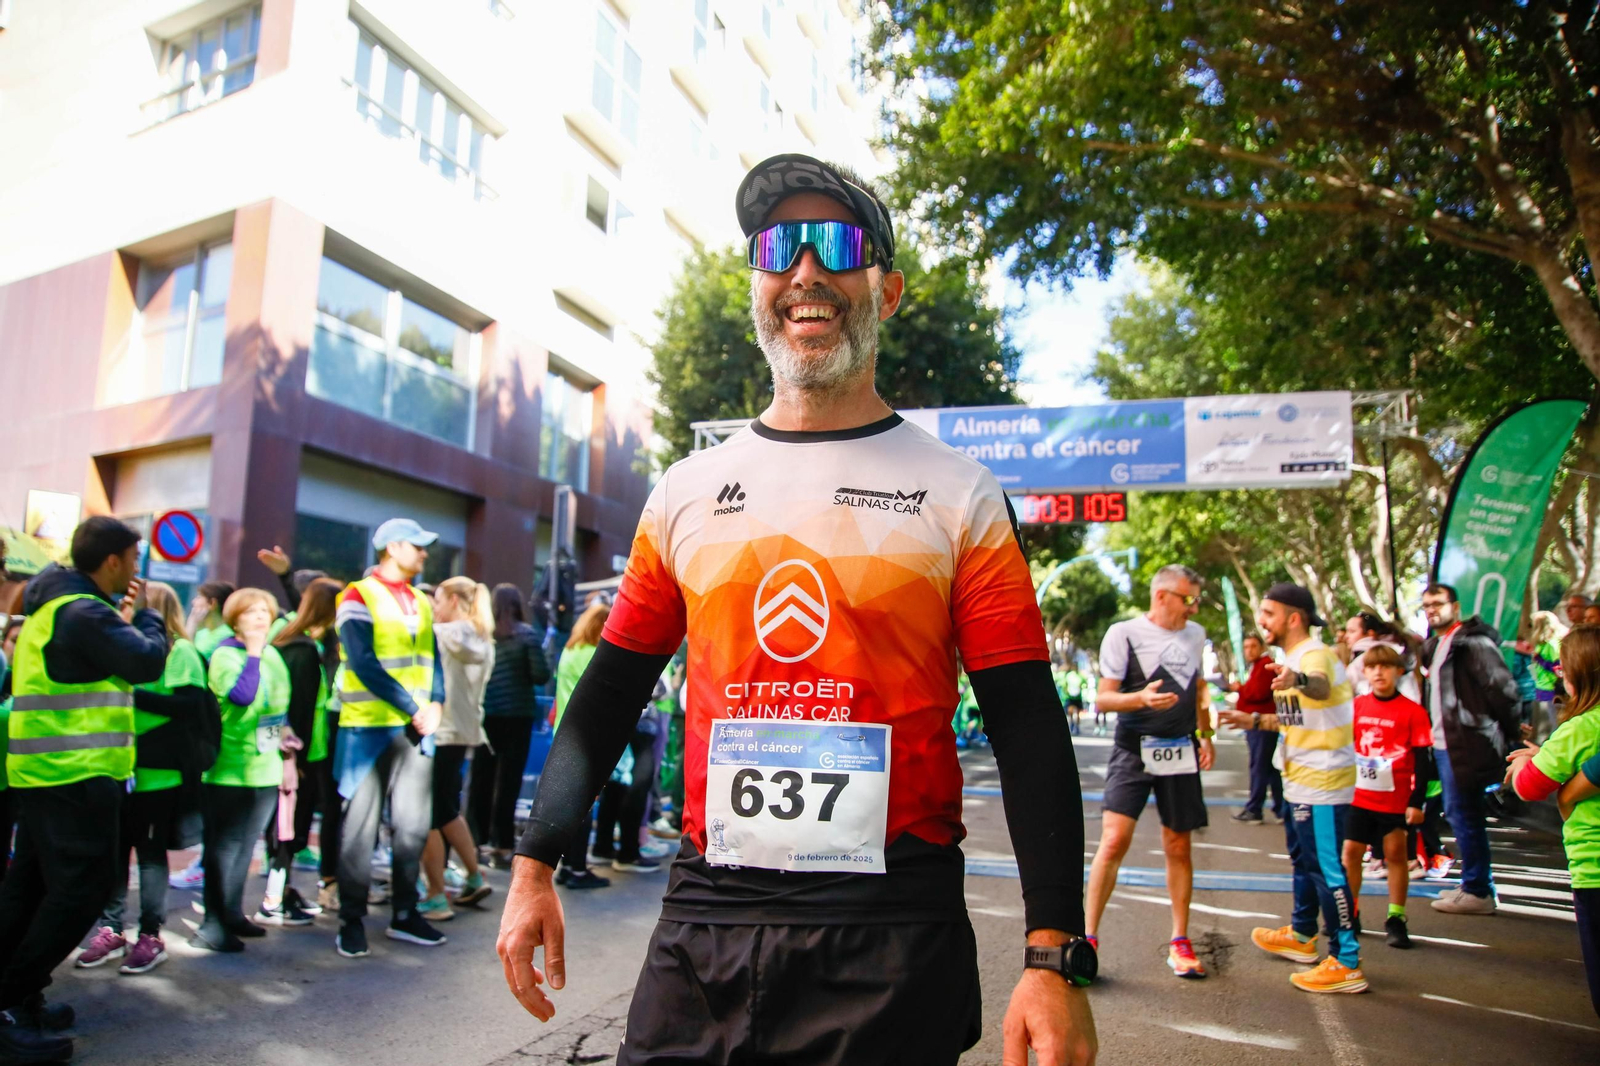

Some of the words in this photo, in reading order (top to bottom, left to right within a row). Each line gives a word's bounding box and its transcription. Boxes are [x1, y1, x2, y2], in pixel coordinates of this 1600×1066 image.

[952, 414, 1041, 437] Almería
[1031, 437, 1055, 459] el
[1060, 436, 1142, 457] cáncer
[714, 503, 745, 516] mobel
[833, 494, 890, 510] SALINAS
[893, 502, 921, 516] CAR
[726, 703, 804, 720] SALINAS
[811, 705, 851, 722] CAR
[719, 727, 753, 738] Amería
[774, 729, 821, 741] marcha
[717, 742, 745, 752] contra
[747, 741, 758, 752] el
[761, 741, 803, 754] cáncer
[1153, 747, 1183, 761] 601
[731, 768, 850, 822] 637
[794, 853, 805, 861] de
[807, 853, 839, 861] febrero
[853, 855, 874, 863] 2025
